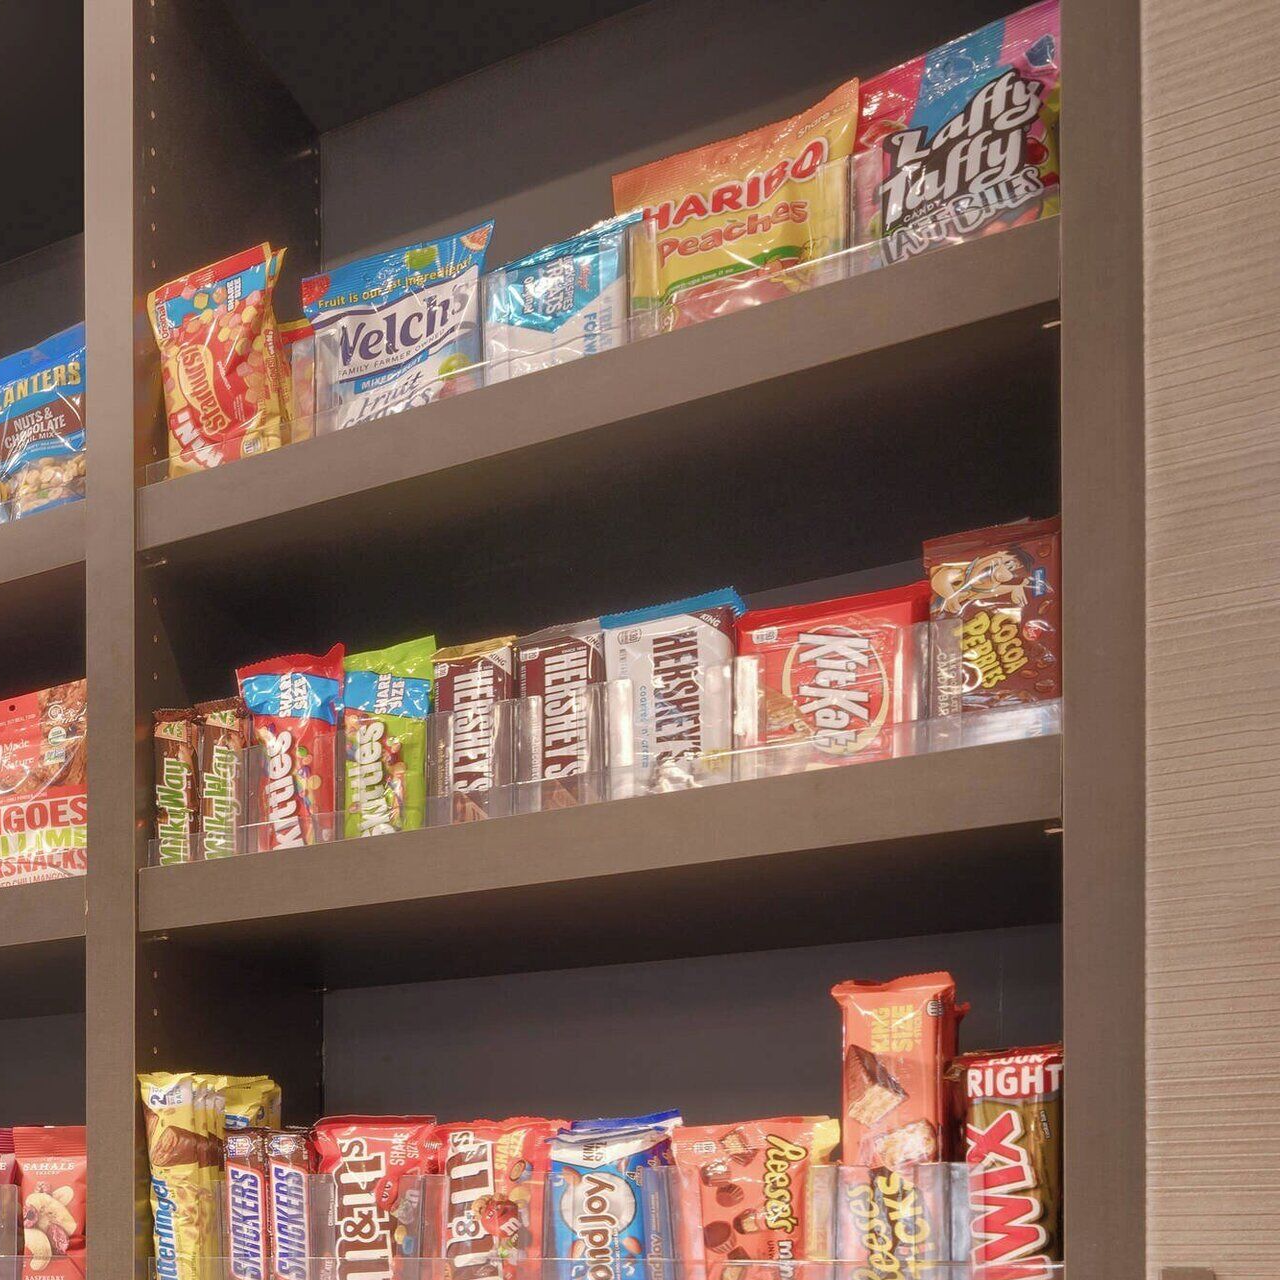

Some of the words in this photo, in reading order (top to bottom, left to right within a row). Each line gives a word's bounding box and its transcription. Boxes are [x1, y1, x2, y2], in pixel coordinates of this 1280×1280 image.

[893, 68, 1045, 170] Laffy
[643, 138, 830, 230] HARIBO
[881, 127, 1023, 228] Taffy
[658, 200, 809, 269] Peaches
[317, 297, 345, 311] Fruit
[13, 408, 44, 432] NUTS
[990, 612, 1029, 674] COCOA
[544, 651, 592, 779] HERSHEY'S
[652, 629, 702, 763] HERSHEY'S
[2, 739, 29, 752] Made
[452, 666, 495, 796] HERSHEY'S
[265, 731, 305, 850] kittles
[893, 1003, 914, 1052] SIZE
[966, 1064, 1064, 1098] RIGHT
[22, 1162, 76, 1172] SAHALE
[390, 1132, 409, 1166] SHARE
[764, 1133, 808, 1234] Reese's
